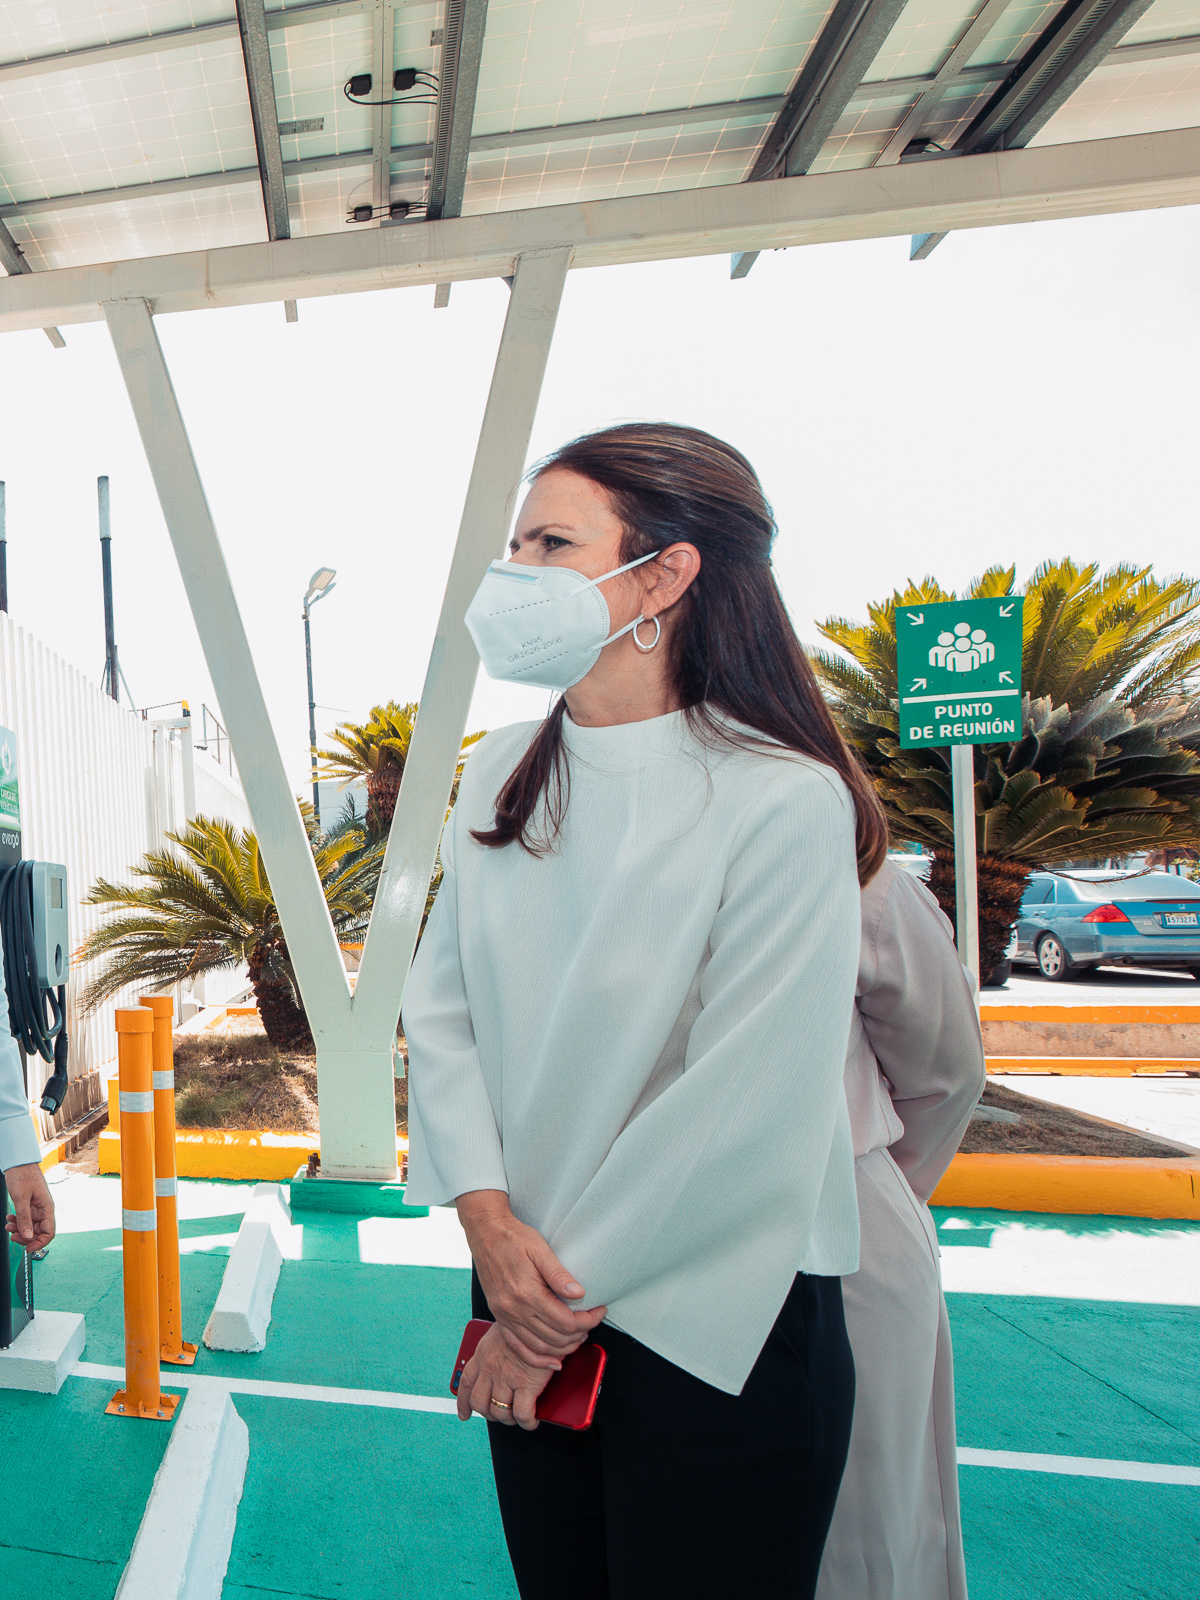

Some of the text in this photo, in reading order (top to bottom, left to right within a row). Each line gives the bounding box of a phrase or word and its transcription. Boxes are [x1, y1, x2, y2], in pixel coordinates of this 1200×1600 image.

[521, 636, 542, 649] KN95
[935, 703, 992, 719] PUNTO
[910, 718, 1014, 740] DE REUNIÓN
